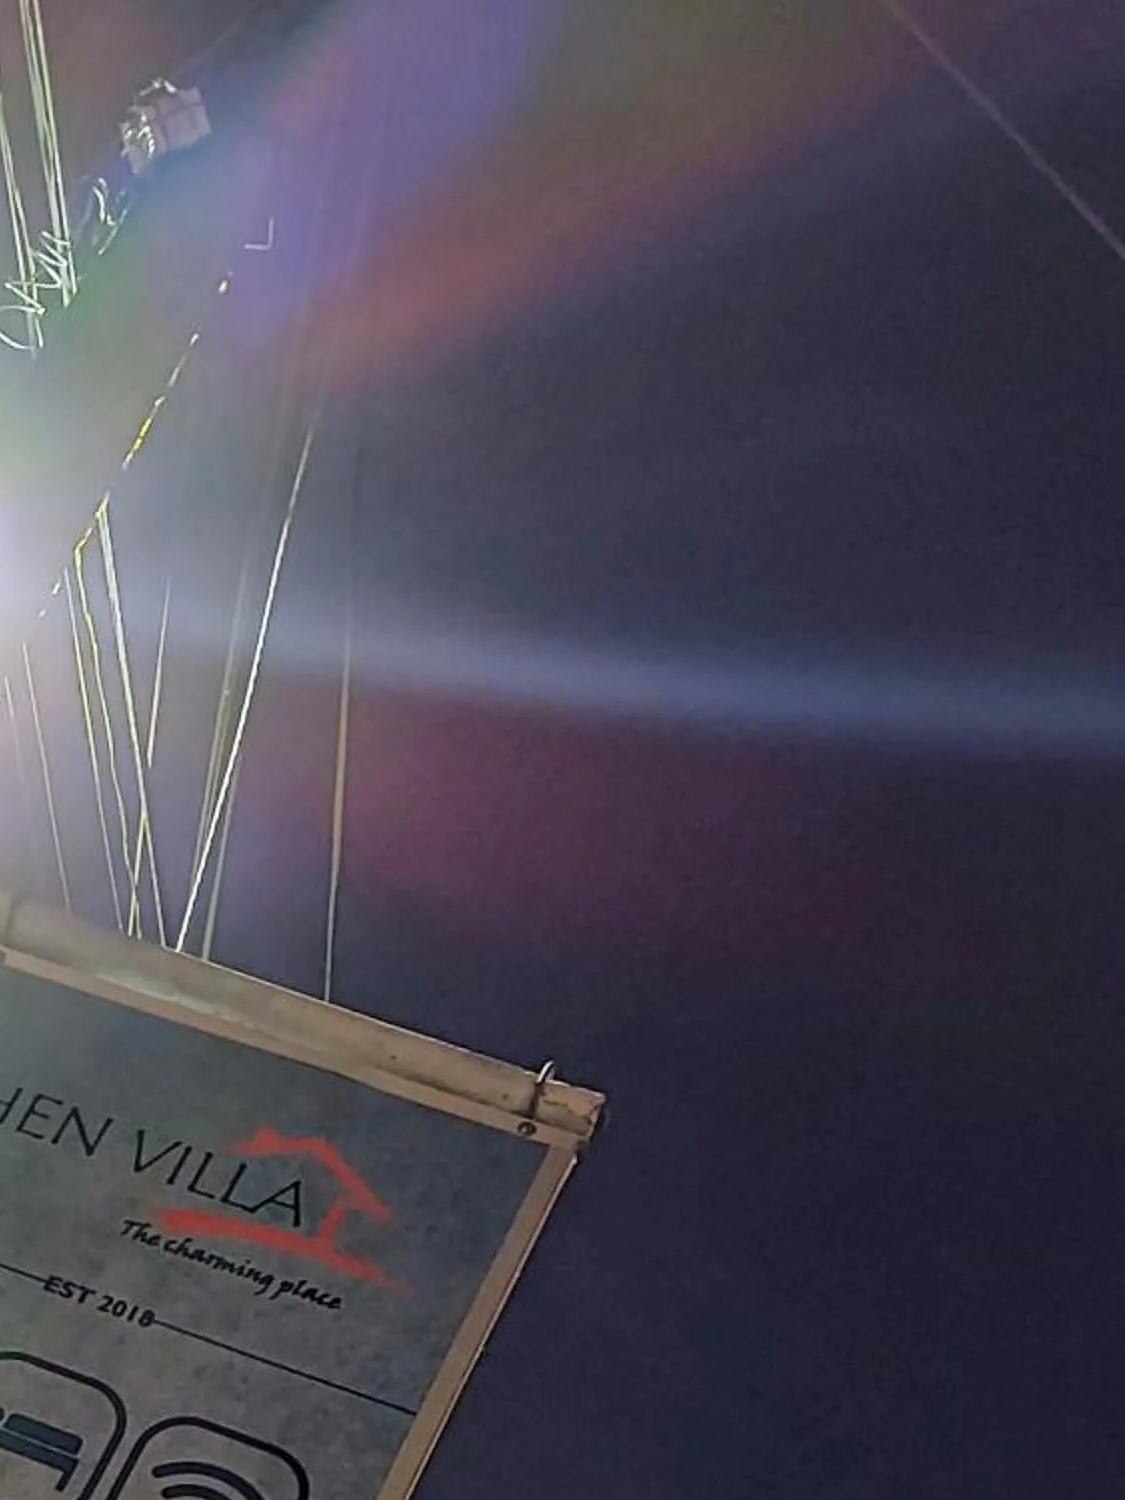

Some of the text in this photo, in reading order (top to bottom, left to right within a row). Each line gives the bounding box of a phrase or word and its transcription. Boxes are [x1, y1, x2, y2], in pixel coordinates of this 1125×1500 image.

[133, 1129, 304, 1228] VILLA
[43, 1275, 156, 1328] EST 2018
[120, 1218, 344, 1311] The charming place
